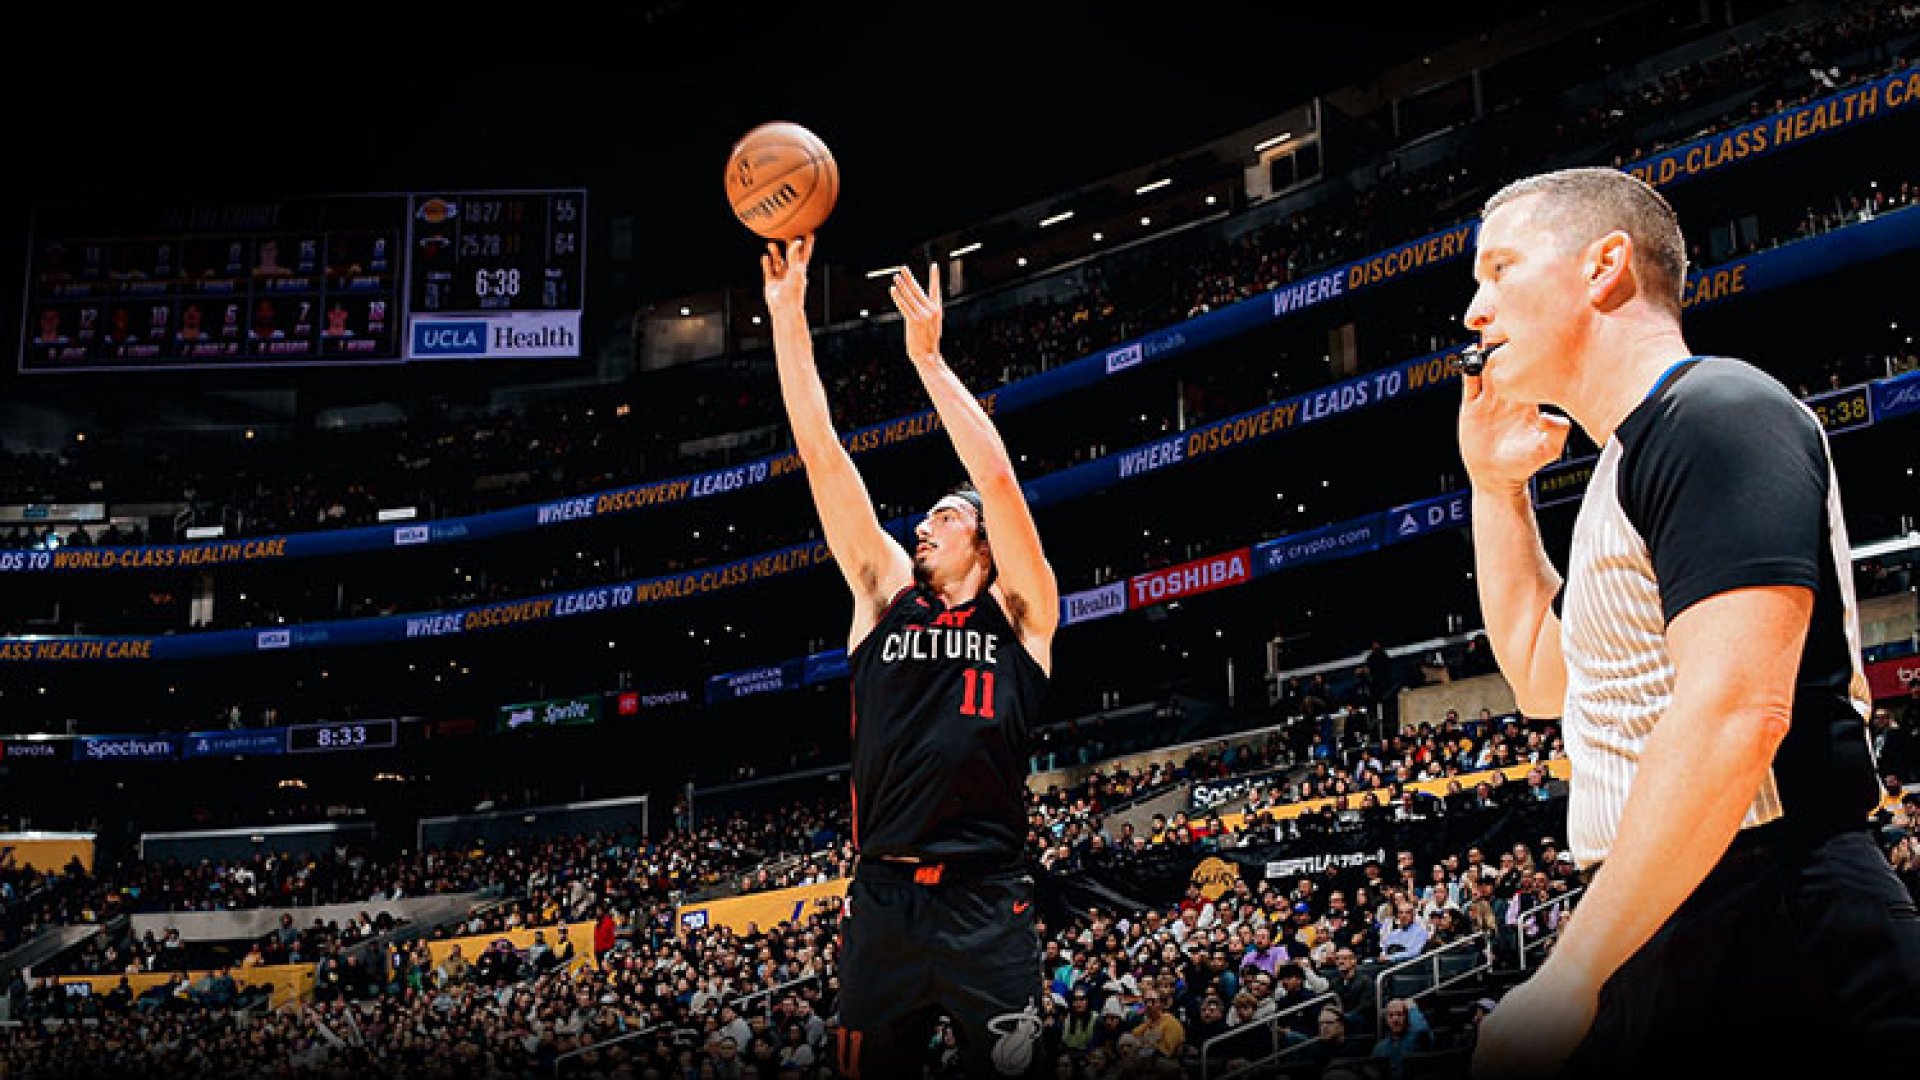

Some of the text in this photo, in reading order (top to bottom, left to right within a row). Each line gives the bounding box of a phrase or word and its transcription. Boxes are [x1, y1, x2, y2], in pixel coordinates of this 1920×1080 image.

[1630, 125, 1768, 187] RLD-CLASS
[1773, 86, 1879, 146] HEALTH
[475, 268, 521, 296] 6:38
[1272, 227, 1471, 316] WHERE DISCOVERY
[1680, 264, 1748, 308] CARE
[424, 326, 575, 349] UCLA Health
[1118, 437, 1184, 479] WHERE
[1187, 403, 1300, 460] DISCOVERY
[1302, 380, 1369, 422] LEADS
[1374, 370, 1402, 401] TO
[537, 496, 596, 525] WHERE
[596, 481, 690, 515] DISCOVERY
[691, 470, 744, 498] LEADS
[746, 462, 768, 484] TO
[28, 551, 51, 570] TO
[53, 547, 176, 569] WORLD-CLASS
[178, 542, 242, 565] HEALTH
[244, 537, 287, 560] CARE
[1286, 526, 1371, 559] crypto.com
[406, 612, 464, 639] WHERE
[465, 600, 554, 631] DISCOVERY
[555, 590, 608, 617] LEADS
[611, 585, 634, 608] TO
[636, 563, 750, 603] WORLD-CLASS
[752, 547, 811, 579] HEALTH
[1133, 555, 1246, 604] TOSHIBA
[1072, 590, 1122, 617] Health
[36, 639, 103, 660] HEALTH
[105, 638, 153, 660] CARE
[881, 628, 1000, 664] CULTURE
[641, 691, 688, 707] TOYOTA
[959, 667, 997, 720] 11
[542, 700, 591, 726] Sprite
[7, 745, 55, 756] TOYOTA
[86, 738, 171, 759] Spectrum
[317, 726, 367, 747] 8:33
